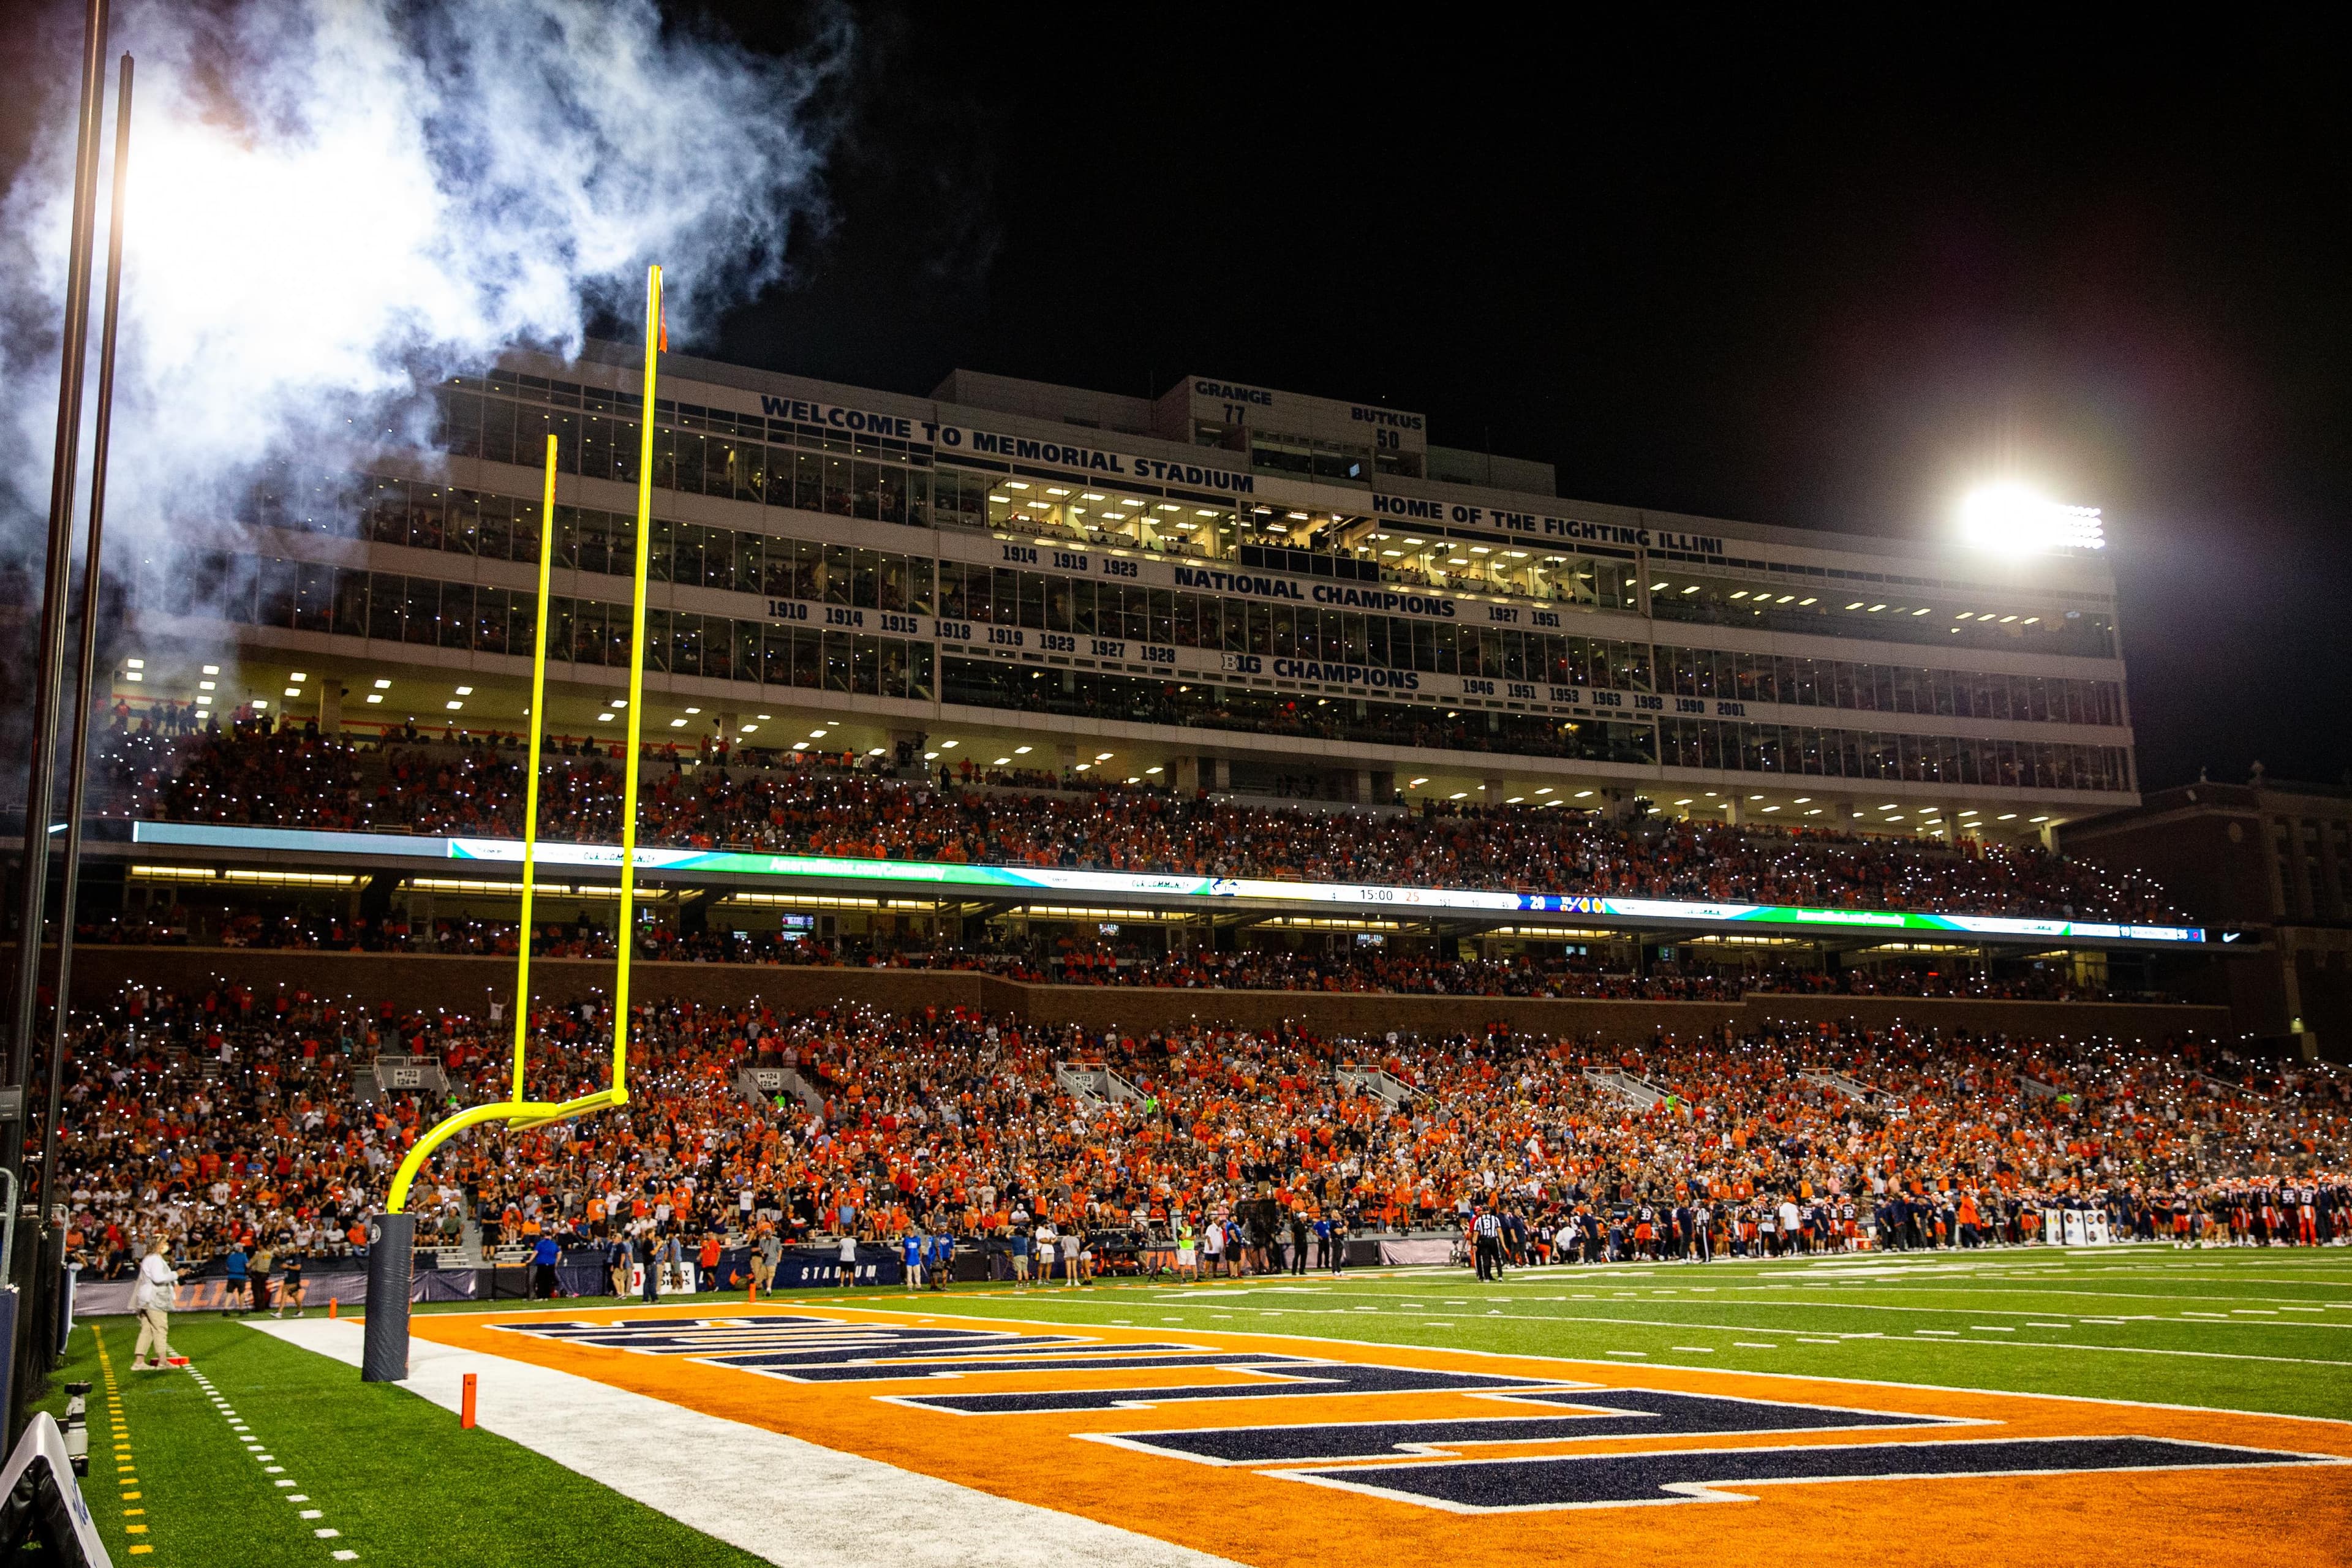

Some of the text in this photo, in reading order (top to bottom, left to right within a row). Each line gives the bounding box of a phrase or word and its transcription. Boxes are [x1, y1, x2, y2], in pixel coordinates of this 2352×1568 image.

[1195, 381, 1272, 405] GRANGE
[1223, 404, 1245, 424] 77
[1352, 407, 1422, 430] BUTKUS
[761, 395, 1253, 493] WELCOME TO MEMORIAL STADIUM
[1377, 428, 1399, 450] 50
[1373, 494, 1722, 554] HOME OF THE FIGHTING ILLINI
[1003, 545, 1560, 627] 1914 1919 1923 NATIONAL CHAMPIONS 1927 1951
[769, 600, 807, 620] 1910
[826, 607, 862, 627] 1914
[881, 614, 917, 633] 1915
[935, 620, 971, 640] 1918
[988, 627, 1023, 646] 1919
[1040, 633, 1075, 652] 1923
[1091, 639, 1125, 658] 1927
[1141, 645, 1175, 663] 1928
[1273, 658, 1419, 689] CHAMPIONS
[1463, 679, 1494, 695] 1946
[1507, 683, 1536, 699] 1951
[1549, 687, 1579, 703] 1953
[1592, 691, 1621, 707] 1963
[1634, 695, 1662, 710] 1983
[1676, 698, 1705, 714] 1990
[1717, 702, 1746, 717] 2001
[1360, 889, 1393, 901] 15:00
[1406, 891, 1420, 902] 25
[1530, 895, 1545, 910] 20
[2282, 1193, 2295, 1204] 55
[1641, 1210, 1651, 1220] 33
[1802, 1210, 1812, 1219] 35
[1843, 1209, 1854, 1219] 32
[1541, 1230, 1550, 1240] 11
[802, 1265, 876, 1280] STADUM
[481, 1315, 2337, 1514] ILLINOIS
